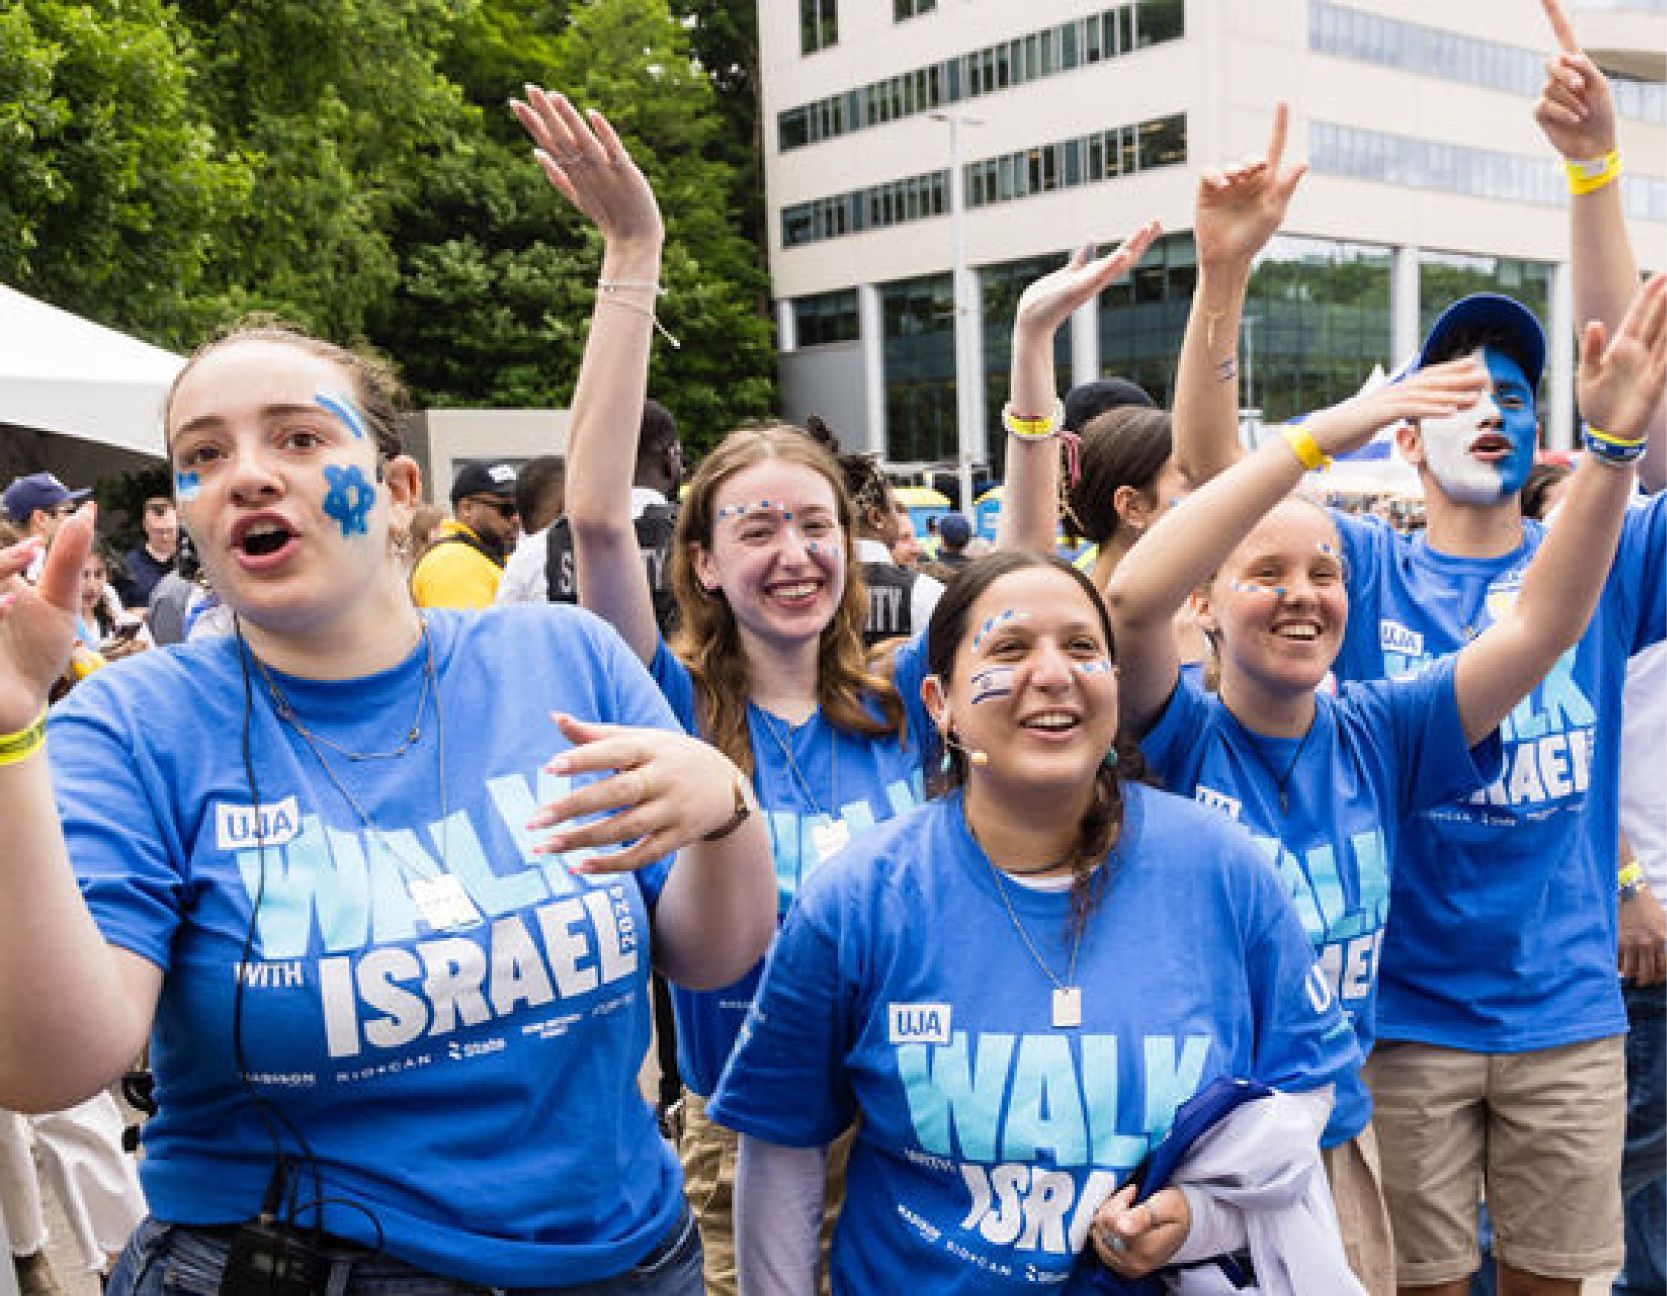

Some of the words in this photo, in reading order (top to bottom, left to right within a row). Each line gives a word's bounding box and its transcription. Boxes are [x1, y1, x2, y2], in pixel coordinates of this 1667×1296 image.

[227, 809, 292, 841] UJA
[234, 961, 304, 988] WITH
[318, 886, 639, 1058] ISRAEL
[897, 1010, 943, 1036] UJA
